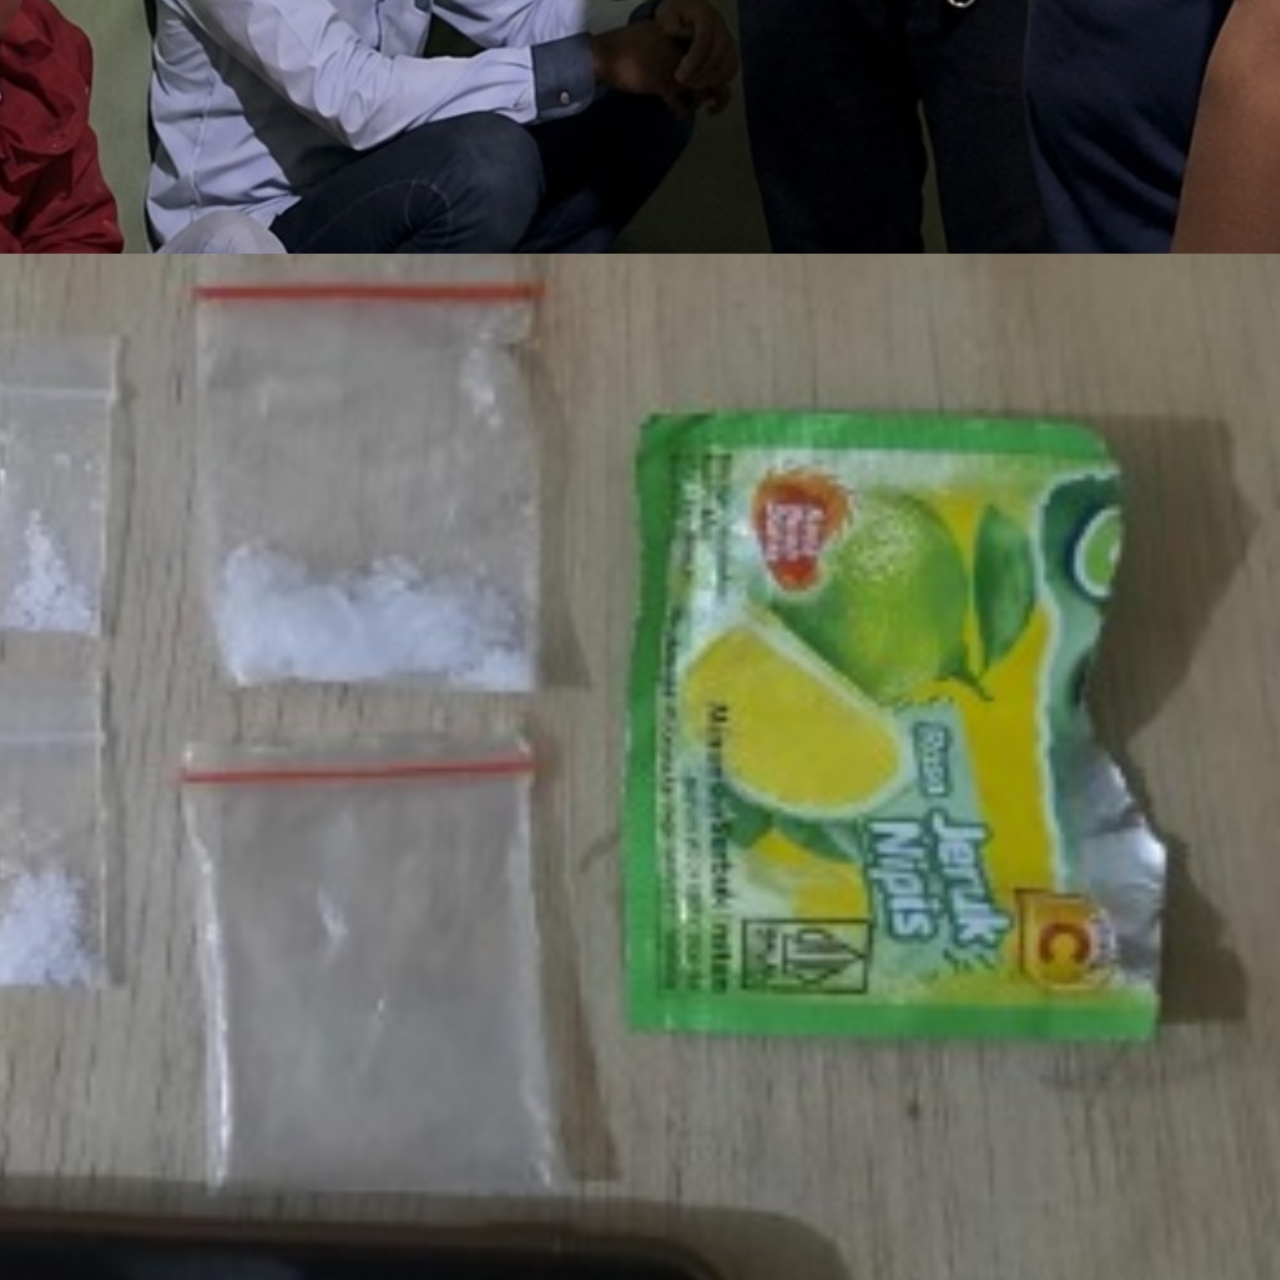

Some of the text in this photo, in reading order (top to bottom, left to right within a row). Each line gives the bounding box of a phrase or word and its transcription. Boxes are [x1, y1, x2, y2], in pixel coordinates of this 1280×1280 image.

[871, 820, 939, 937] Nipis
[931, 810, 1011, 944] Jeruk
[1040, 923, 1090, 965] C
